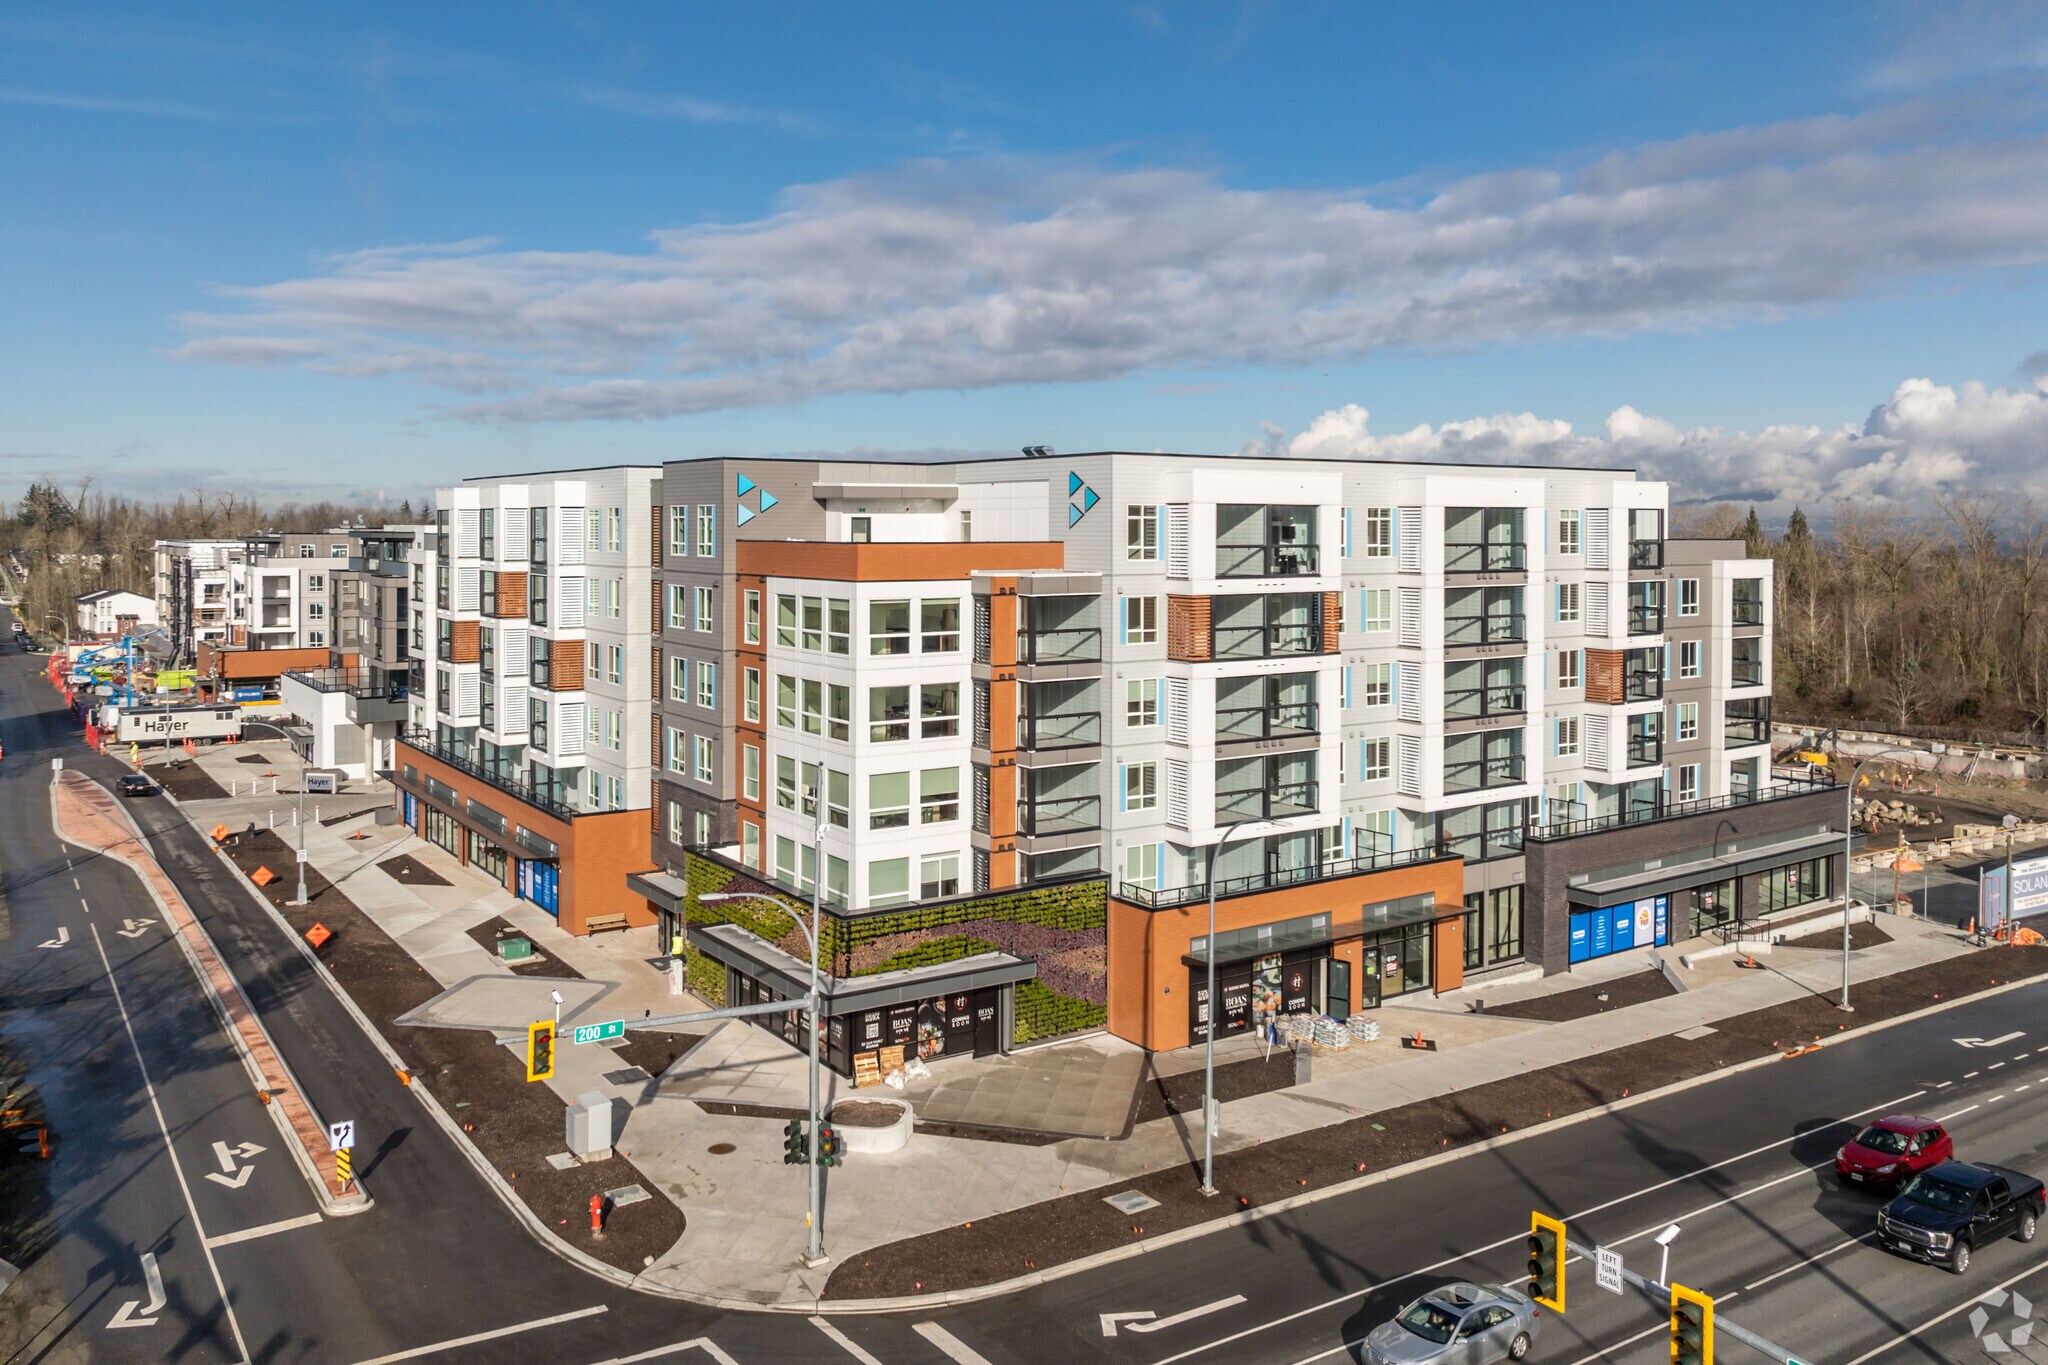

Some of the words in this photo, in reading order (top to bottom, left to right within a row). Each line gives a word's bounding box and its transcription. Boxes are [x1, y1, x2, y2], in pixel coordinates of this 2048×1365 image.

[145, 721, 189, 736] Hayer
[307, 778, 329, 788] Hayer
[893, 1017, 912, 1028] BOAS
[952, 1020, 970, 1028] SOON
[578, 1026, 601, 1042] 200
[608, 1025, 616, 1034] St
[1602, 1253, 1617, 1265] LEFT
[1601, 1263, 1617, 1276] TURN
[1599, 1273, 1620, 1290] SIGNAL
